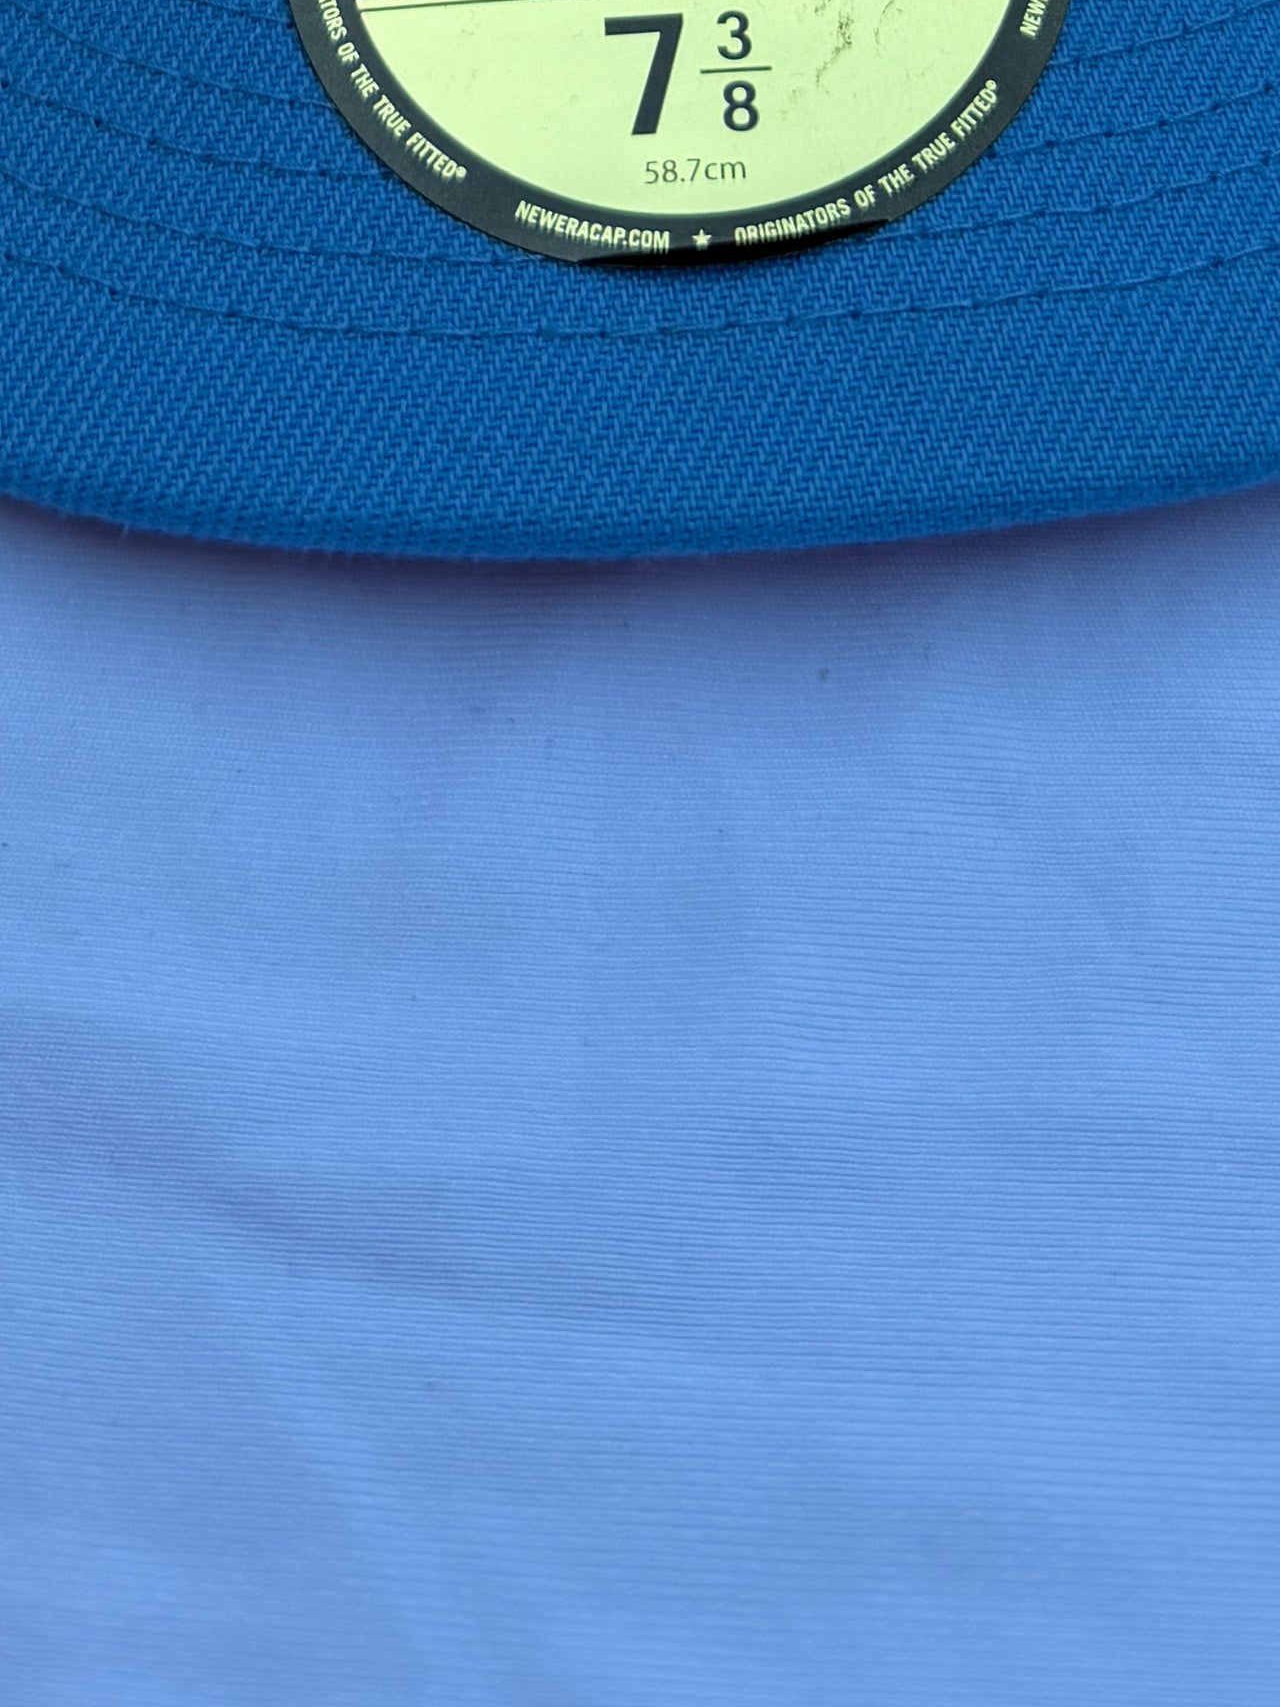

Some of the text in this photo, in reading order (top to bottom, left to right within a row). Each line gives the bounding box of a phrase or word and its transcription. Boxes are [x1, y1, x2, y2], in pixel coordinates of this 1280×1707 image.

[716, 9, 753, 61] 3
[337, 41, 360, 64] OF
[350, 63, 380, 98] THE
[373, 94, 412, 136] TRUE
[603, 11, 684, 136] 7
[722, 79, 761, 133] 8
[514, 199, 671, 254] NEWERACAP.COM
[734, 197, 852, 248] ORIGINATORS
[853, 183, 877, 211] OF
[877, 162, 915, 196] THE
[911, 131, 955, 173] TRUE
[644, 157, 748, 185] 58.7cm
